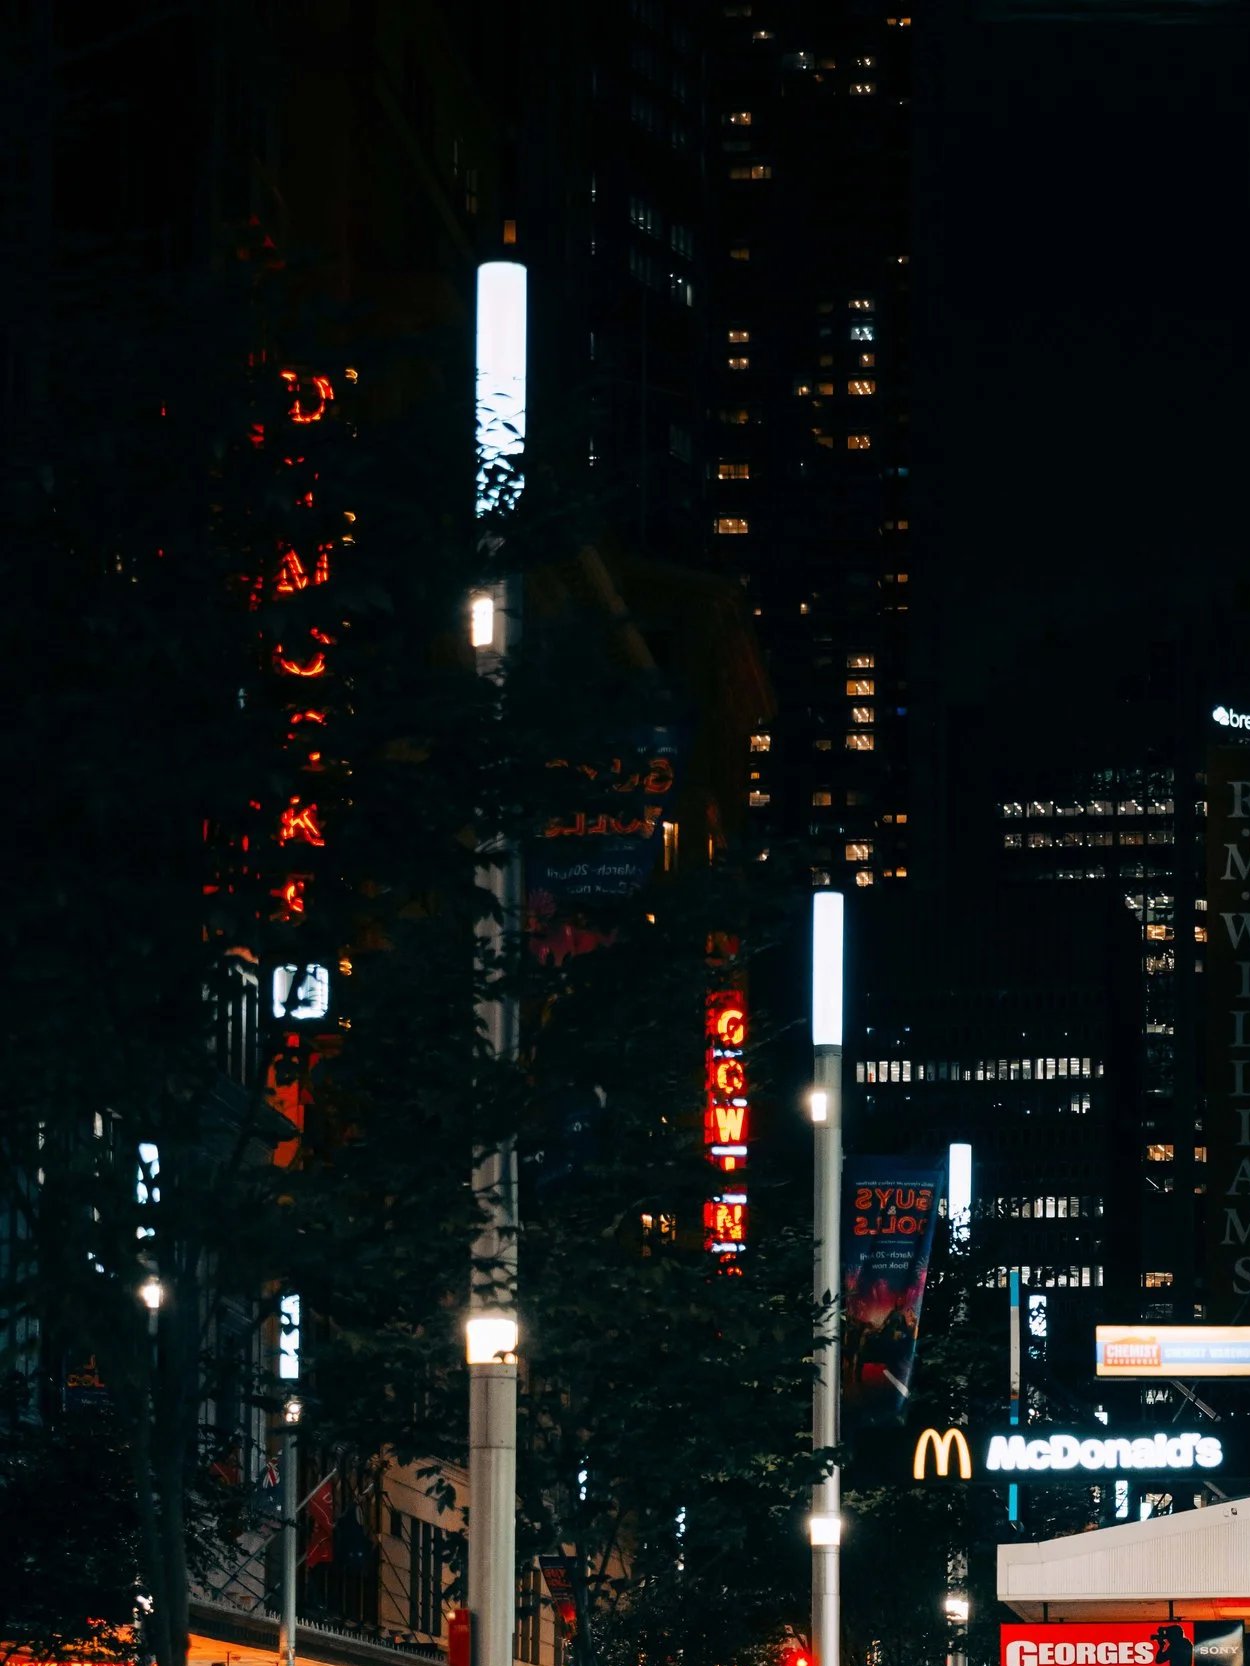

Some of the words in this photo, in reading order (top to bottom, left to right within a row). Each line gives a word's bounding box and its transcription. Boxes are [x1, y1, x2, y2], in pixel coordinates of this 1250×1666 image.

[1106, 1344, 1158, 1358] CHEMIST
[986, 1433, 1223, 1471] McDonald's
[1199, 1646, 1239, 1655] SONY
